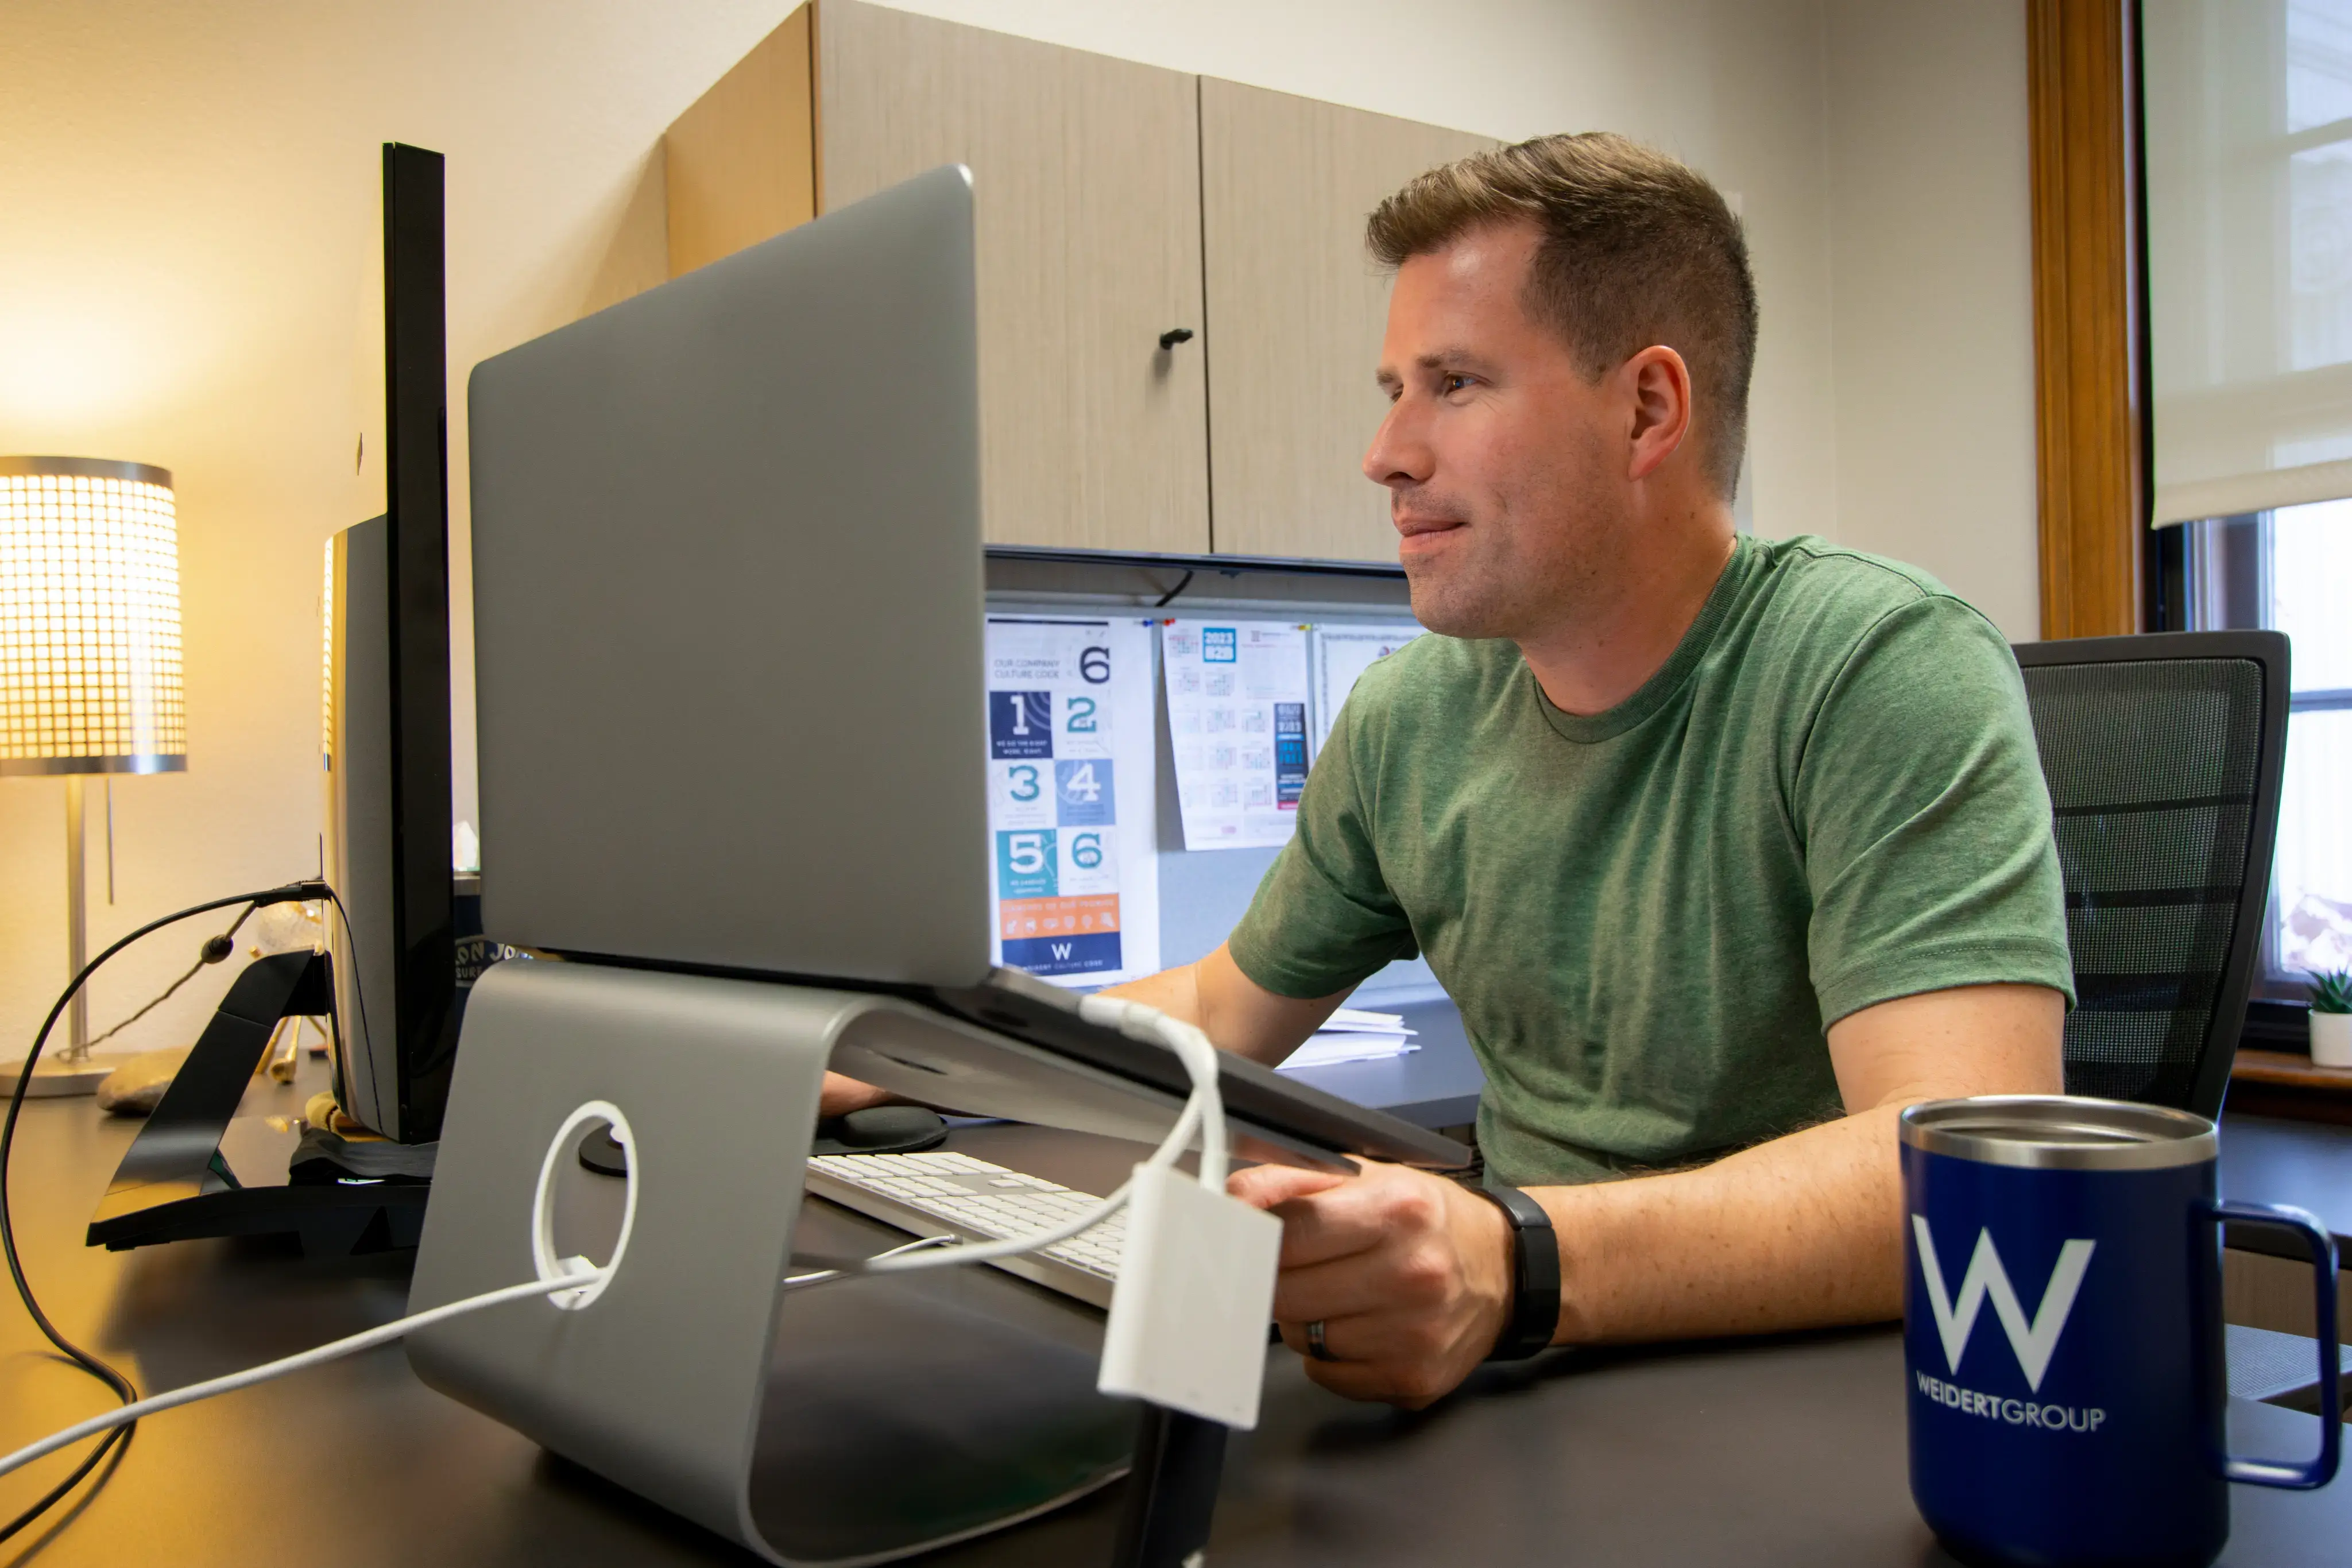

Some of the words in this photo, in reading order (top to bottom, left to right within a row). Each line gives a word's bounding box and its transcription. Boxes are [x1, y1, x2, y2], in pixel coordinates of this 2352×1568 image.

[994, 659, 1013, 667] OUR
[1015, 659, 1061, 667] COMPANY
[994, 669, 1032, 679] CULTURE
[1035, 669, 1059, 679] CODE
[1078, 646, 1111, 684] 6
[1010, 695, 1030, 735] 1
[1066, 697, 1097, 733] 2
[1009, 765, 1040, 802] 3
[1066, 761, 1101, 802] 4
[1009, 834, 1044, 874] 5
[1071, 832, 1102, 869] 6
[1051, 943, 1072, 961] W
[1911, 1213, 2097, 1395] W
